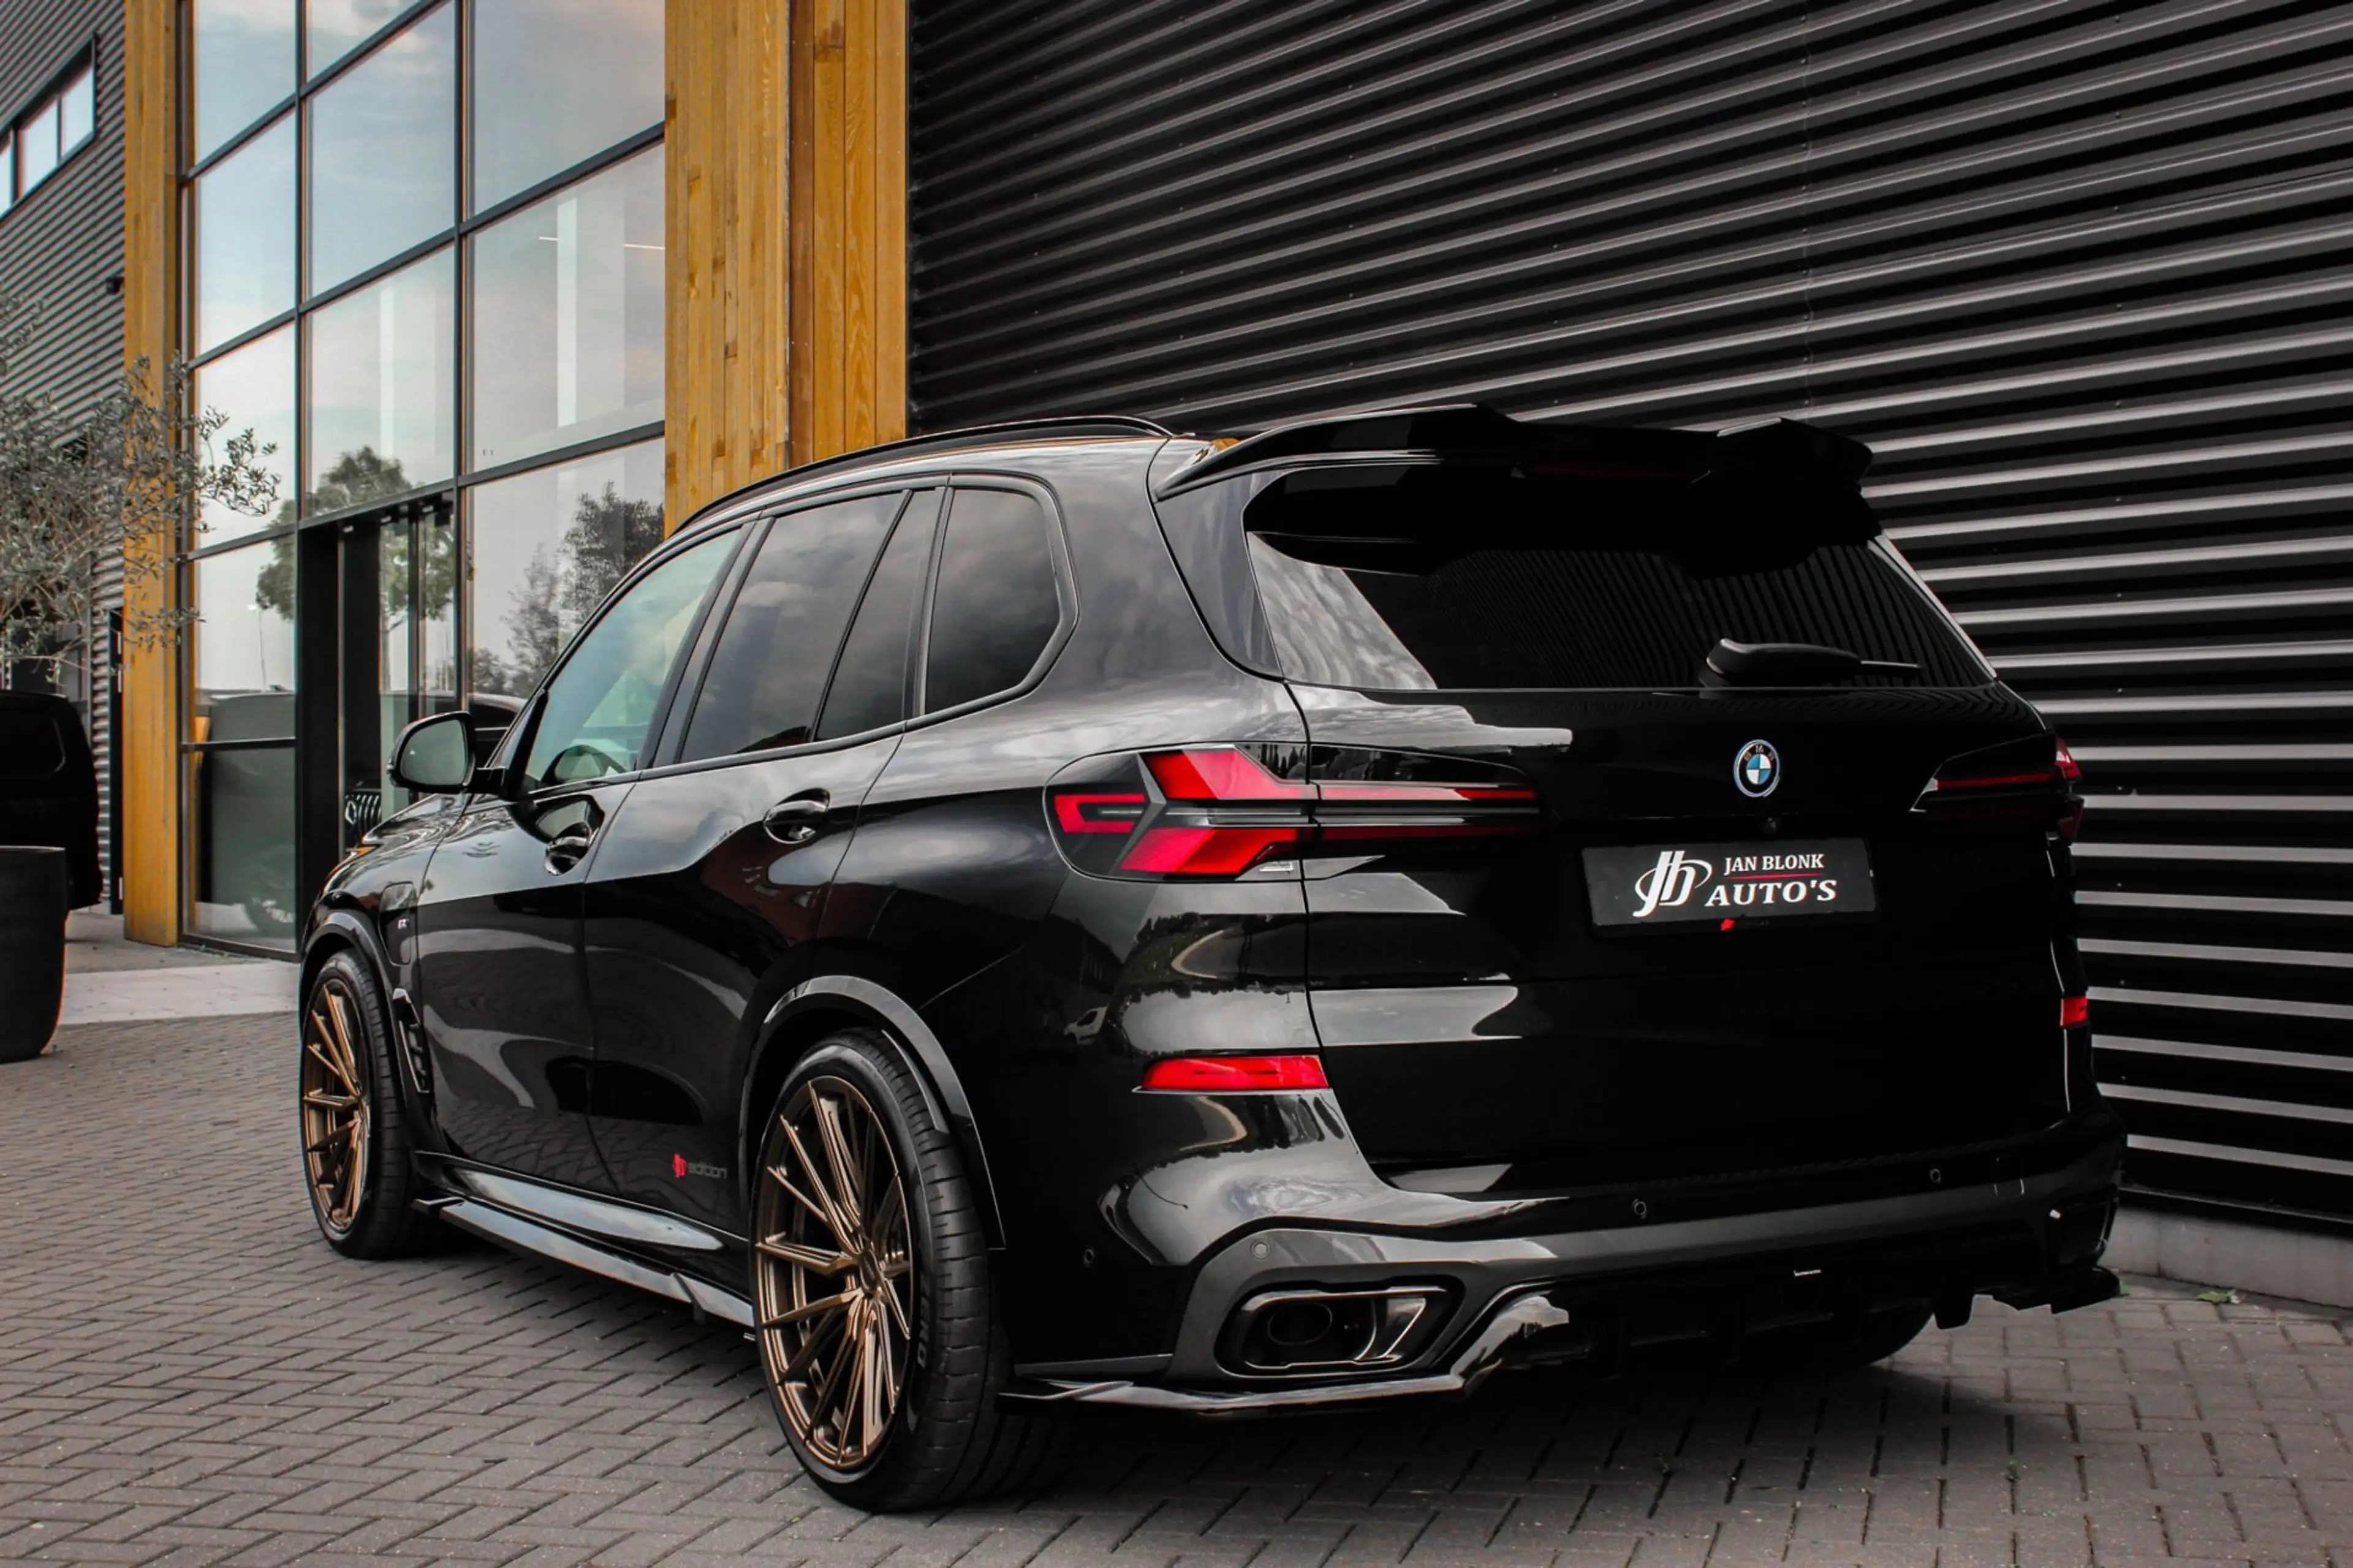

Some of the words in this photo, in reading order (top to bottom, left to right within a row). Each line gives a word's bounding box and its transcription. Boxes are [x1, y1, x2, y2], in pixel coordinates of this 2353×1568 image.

[1723, 856, 1758, 876] JAN
[1762, 854, 1825, 871] BLONK
[1703, 879, 1838, 907] AUTO'S
